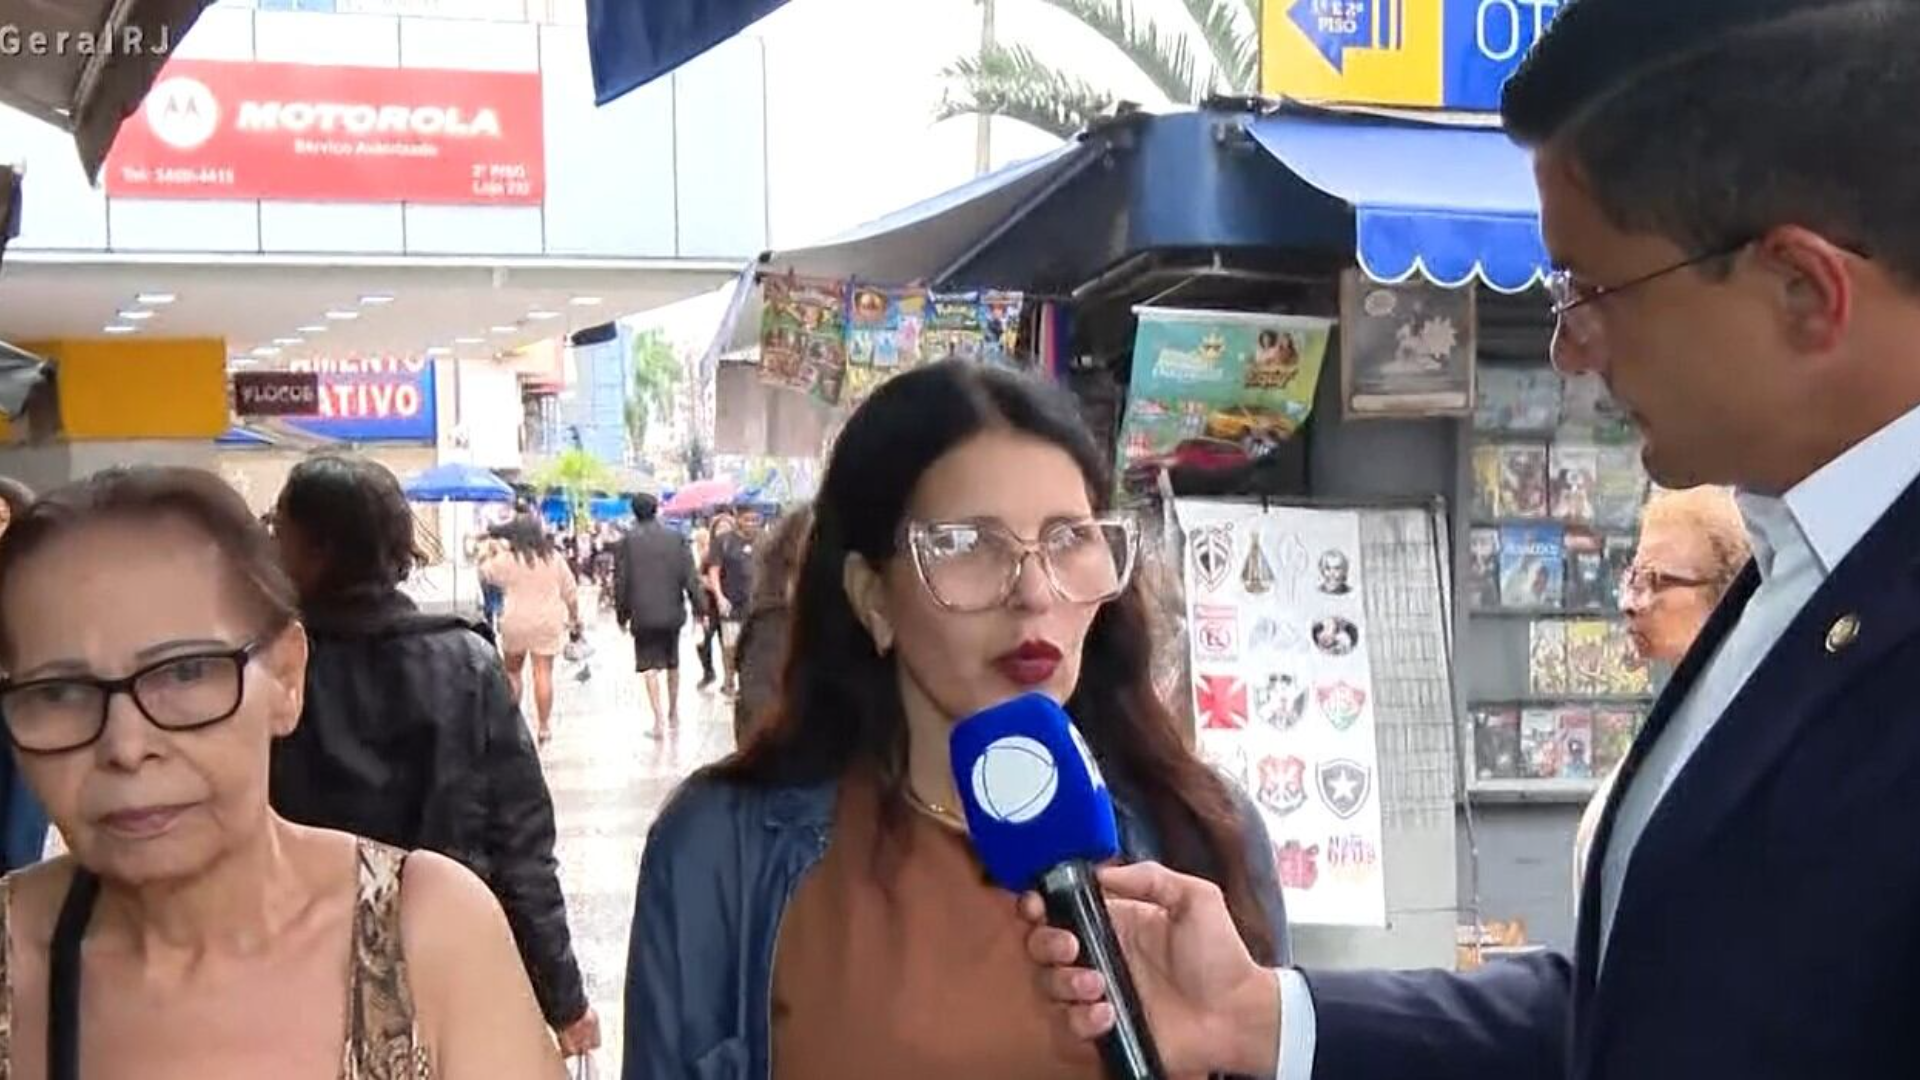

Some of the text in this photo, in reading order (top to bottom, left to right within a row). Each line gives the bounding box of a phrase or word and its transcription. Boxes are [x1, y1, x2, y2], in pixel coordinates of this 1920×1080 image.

[1317, 16, 1358, 33] PISO
[1476, 0, 1568, 60] OT
[236, 100, 501, 138] MOTOROLA
